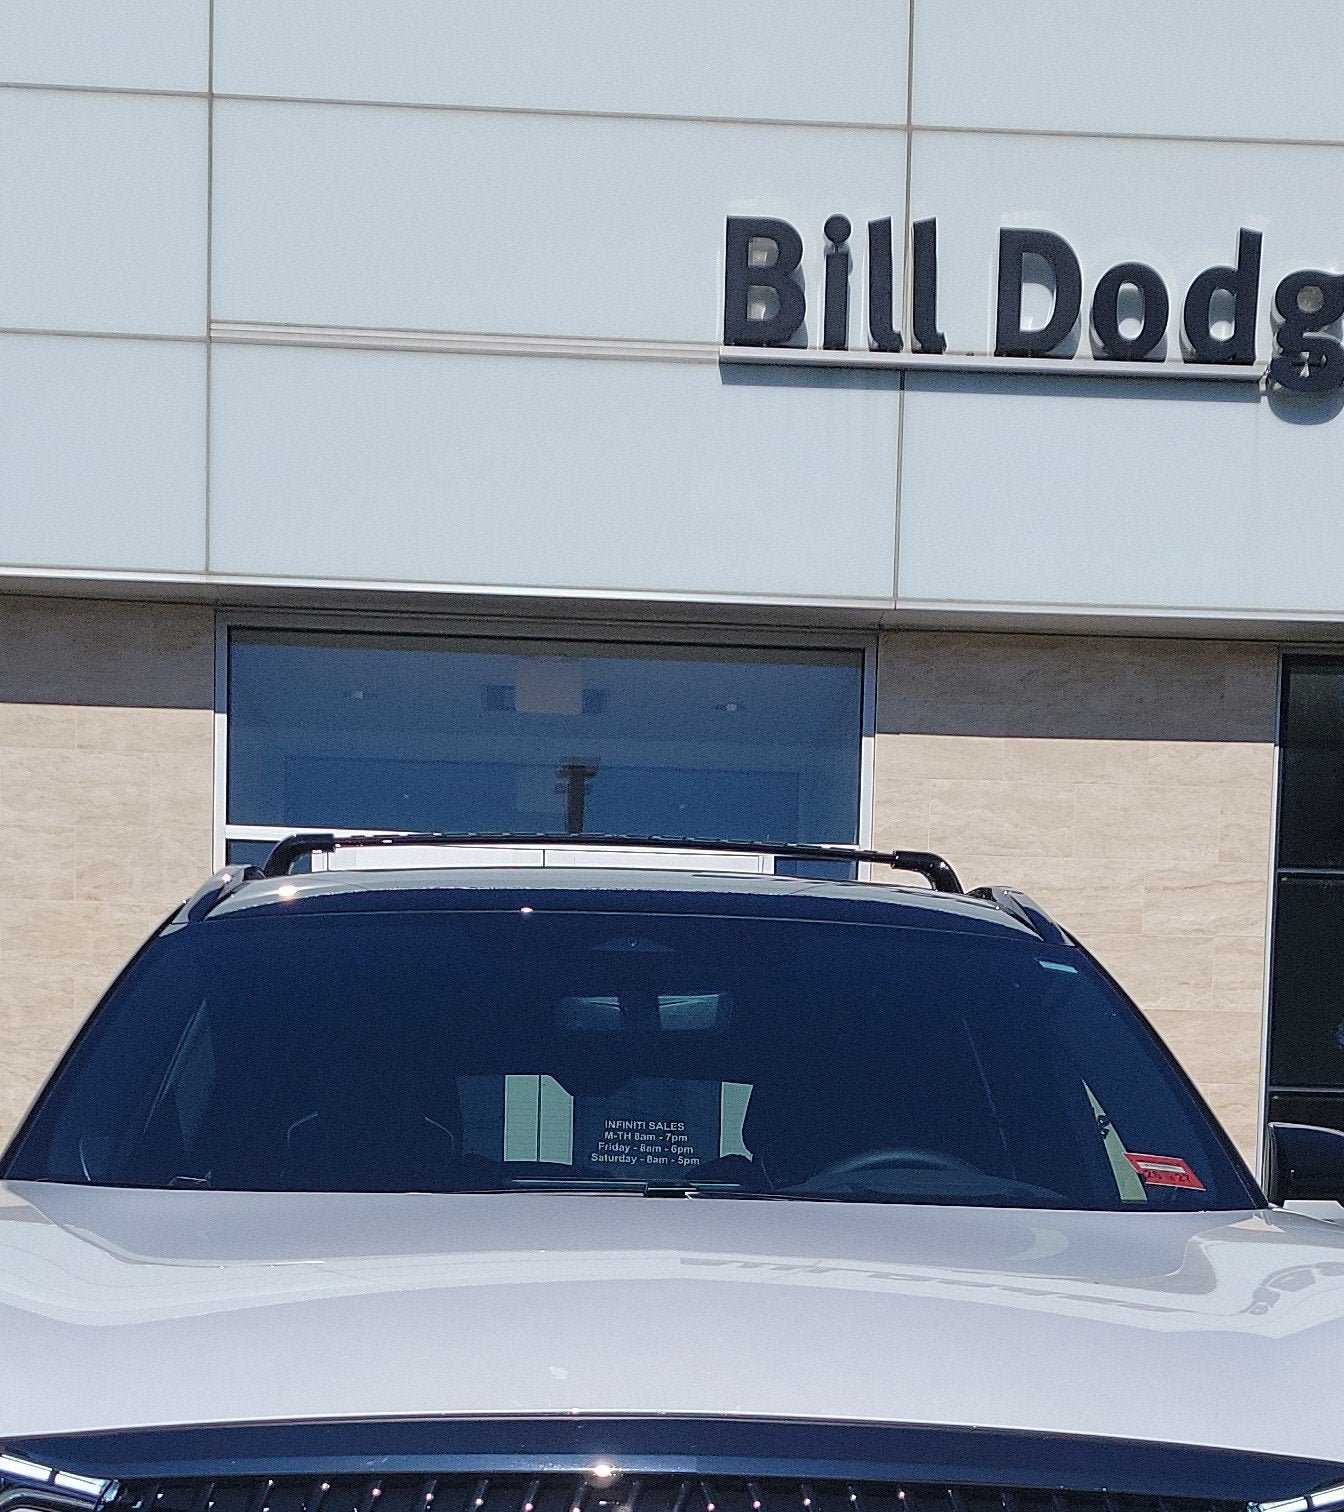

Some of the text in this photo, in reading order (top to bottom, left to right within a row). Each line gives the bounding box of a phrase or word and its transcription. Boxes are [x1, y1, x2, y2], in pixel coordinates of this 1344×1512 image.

[723, 214, 947, 354] Bill
[605, 1120, 685, 1131] INFINITI SALES
[604, 1131, 632, 1141] M-TH
[634, 1132, 656, 1141] 8am
[665, 1133, 688, 1143] 7pm
[598, 1141, 631, 1153] Friday
[670, 1144, 694, 1155] 6pm
[591, 1152, 638, 1165] Saturday
[677, 1155, 700, 1167] 5pm
